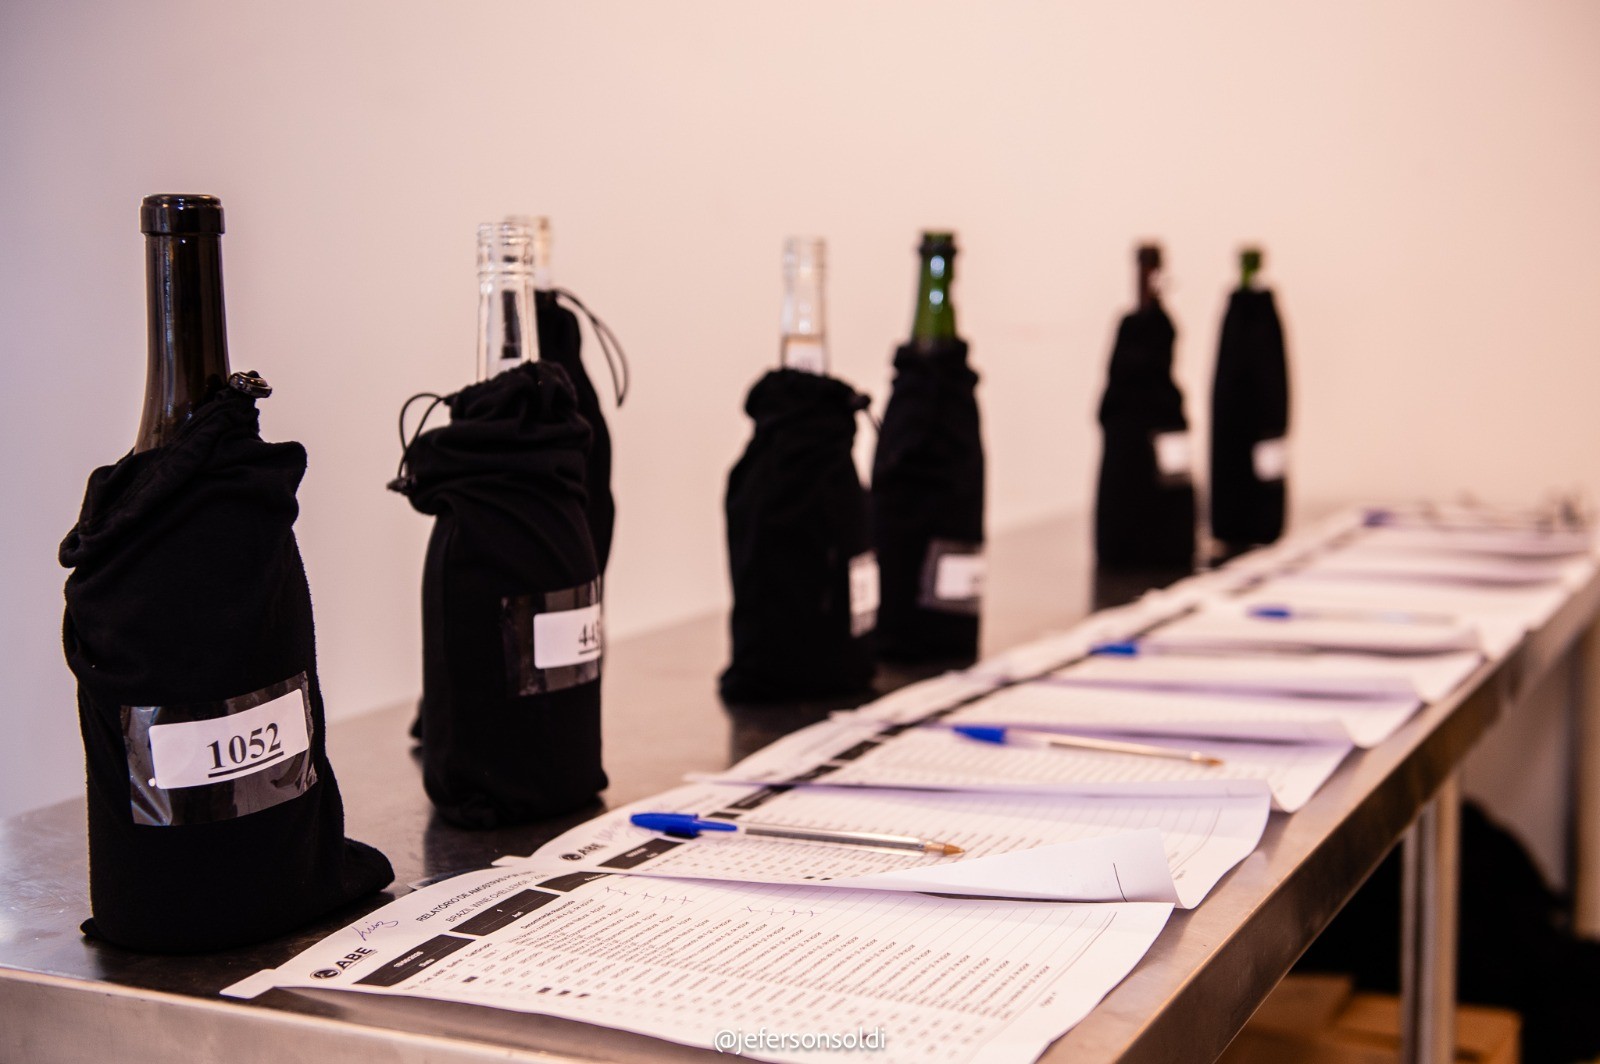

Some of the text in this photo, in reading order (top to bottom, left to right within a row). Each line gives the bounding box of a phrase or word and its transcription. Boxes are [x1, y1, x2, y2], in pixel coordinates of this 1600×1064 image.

[207, 723, 281, 770] 1052
[445, 907, 474, 922] BRAZIL
[336, 947, 373, 970] ABE
